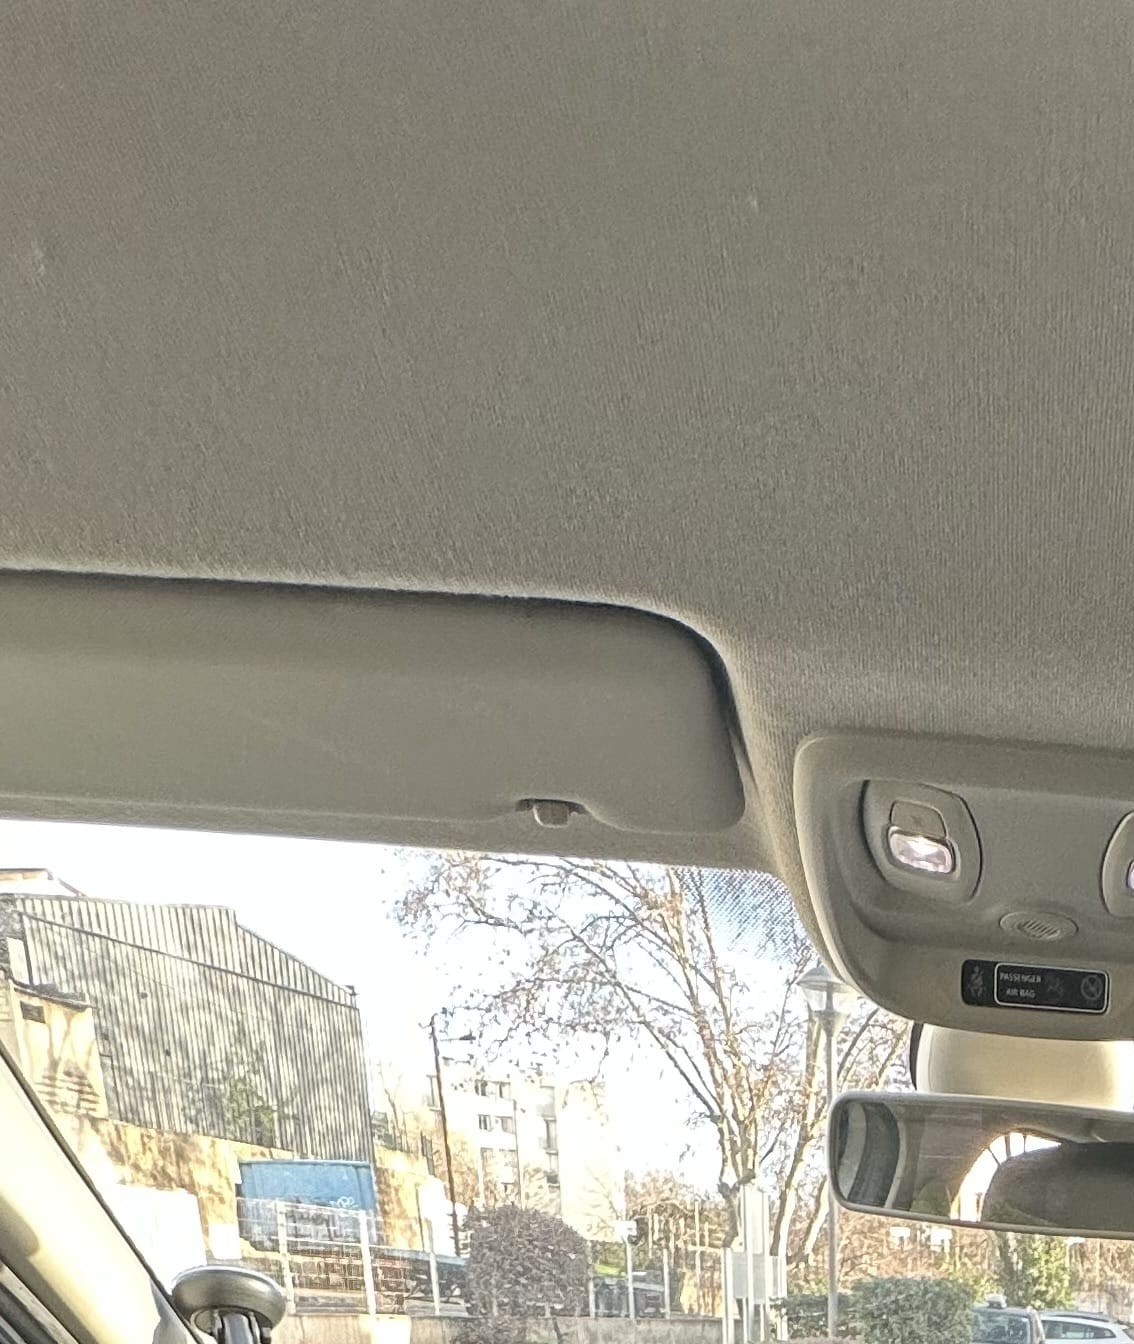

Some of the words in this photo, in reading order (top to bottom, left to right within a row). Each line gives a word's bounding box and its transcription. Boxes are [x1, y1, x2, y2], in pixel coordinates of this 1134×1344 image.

[1000, 972, 1042, 984] PASSENGER
[1006, 987, 1018, 998] AIR
[1020, 988, 1036, 999] BAG
